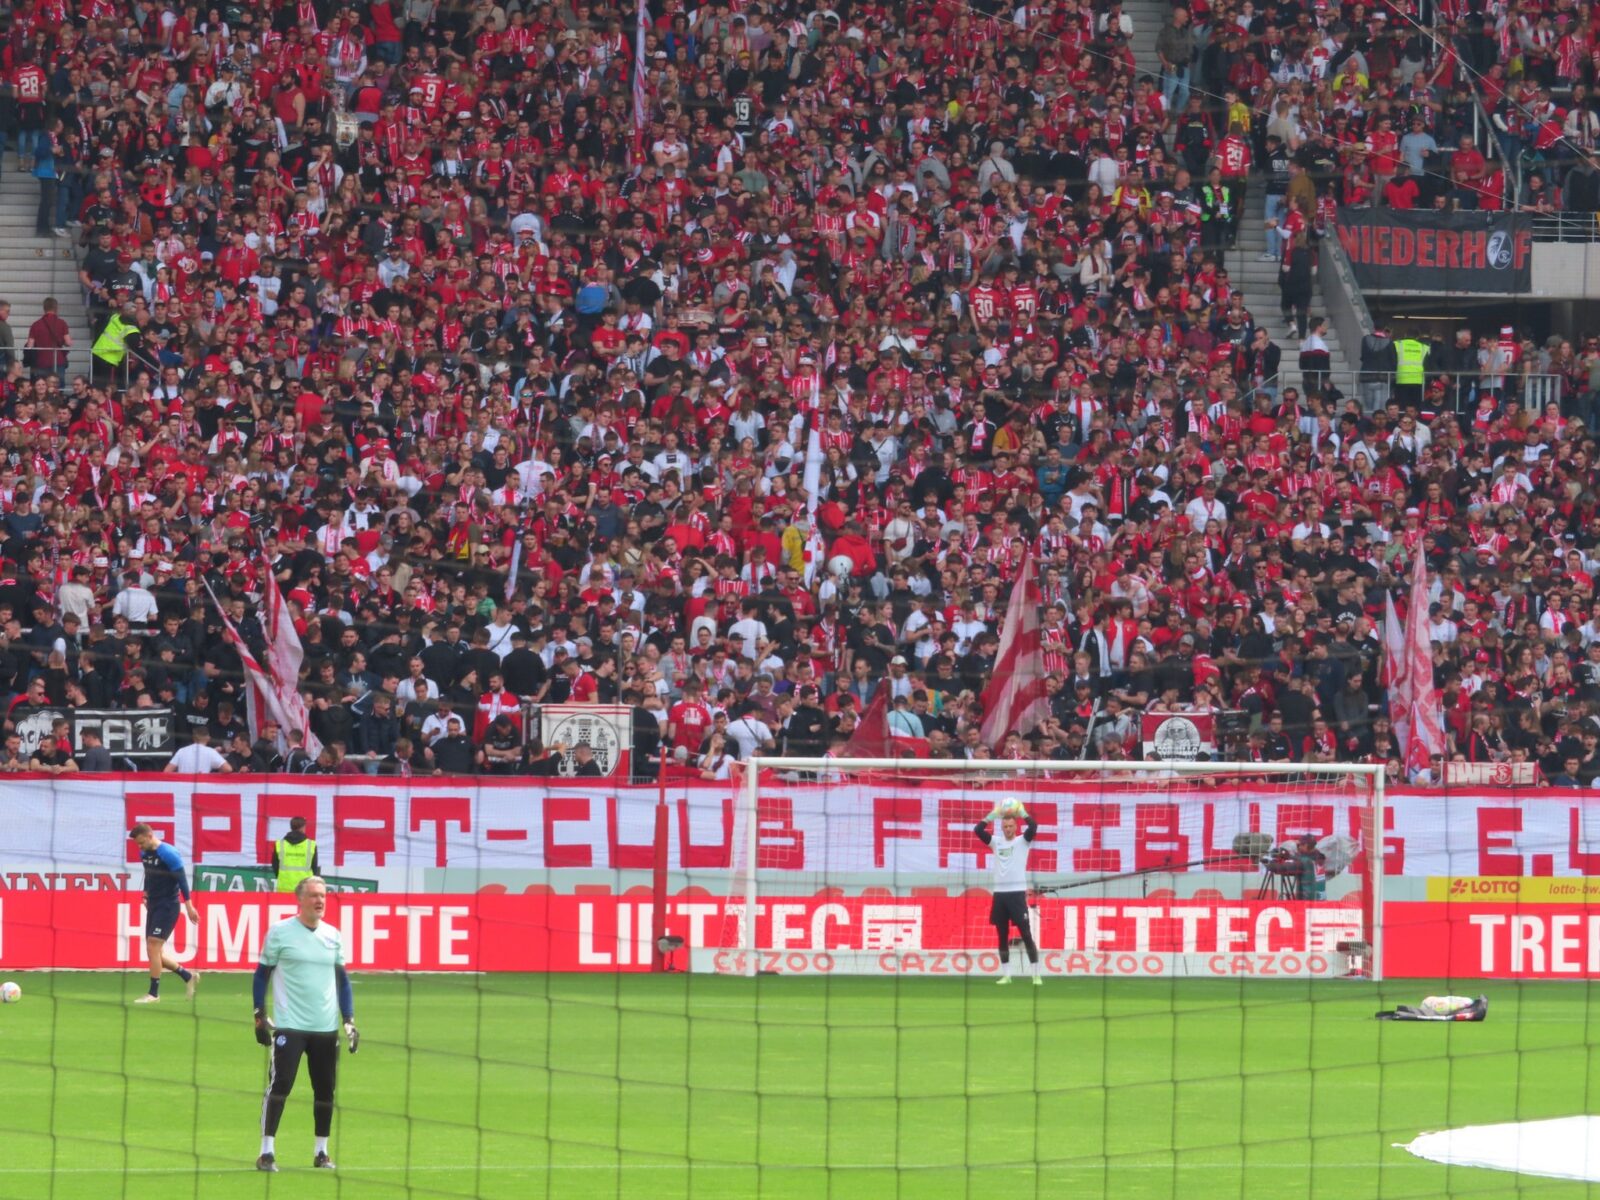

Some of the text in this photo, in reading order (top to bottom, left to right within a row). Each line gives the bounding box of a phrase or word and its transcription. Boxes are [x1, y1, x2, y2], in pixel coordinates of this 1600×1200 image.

[20, 76, 39, 97] 28
[426, 83, 437, 102] 9
[735, 102, 749, 120] 19
[975, 298, 993, 318] 30
[1471, 880, 1521, 894] LOTTO
[879, 952, 1000, 973] CAZOO
[1045, 953, 1165, 974] CAZOO
[1208, 955, 1329, 975] CAZOO
